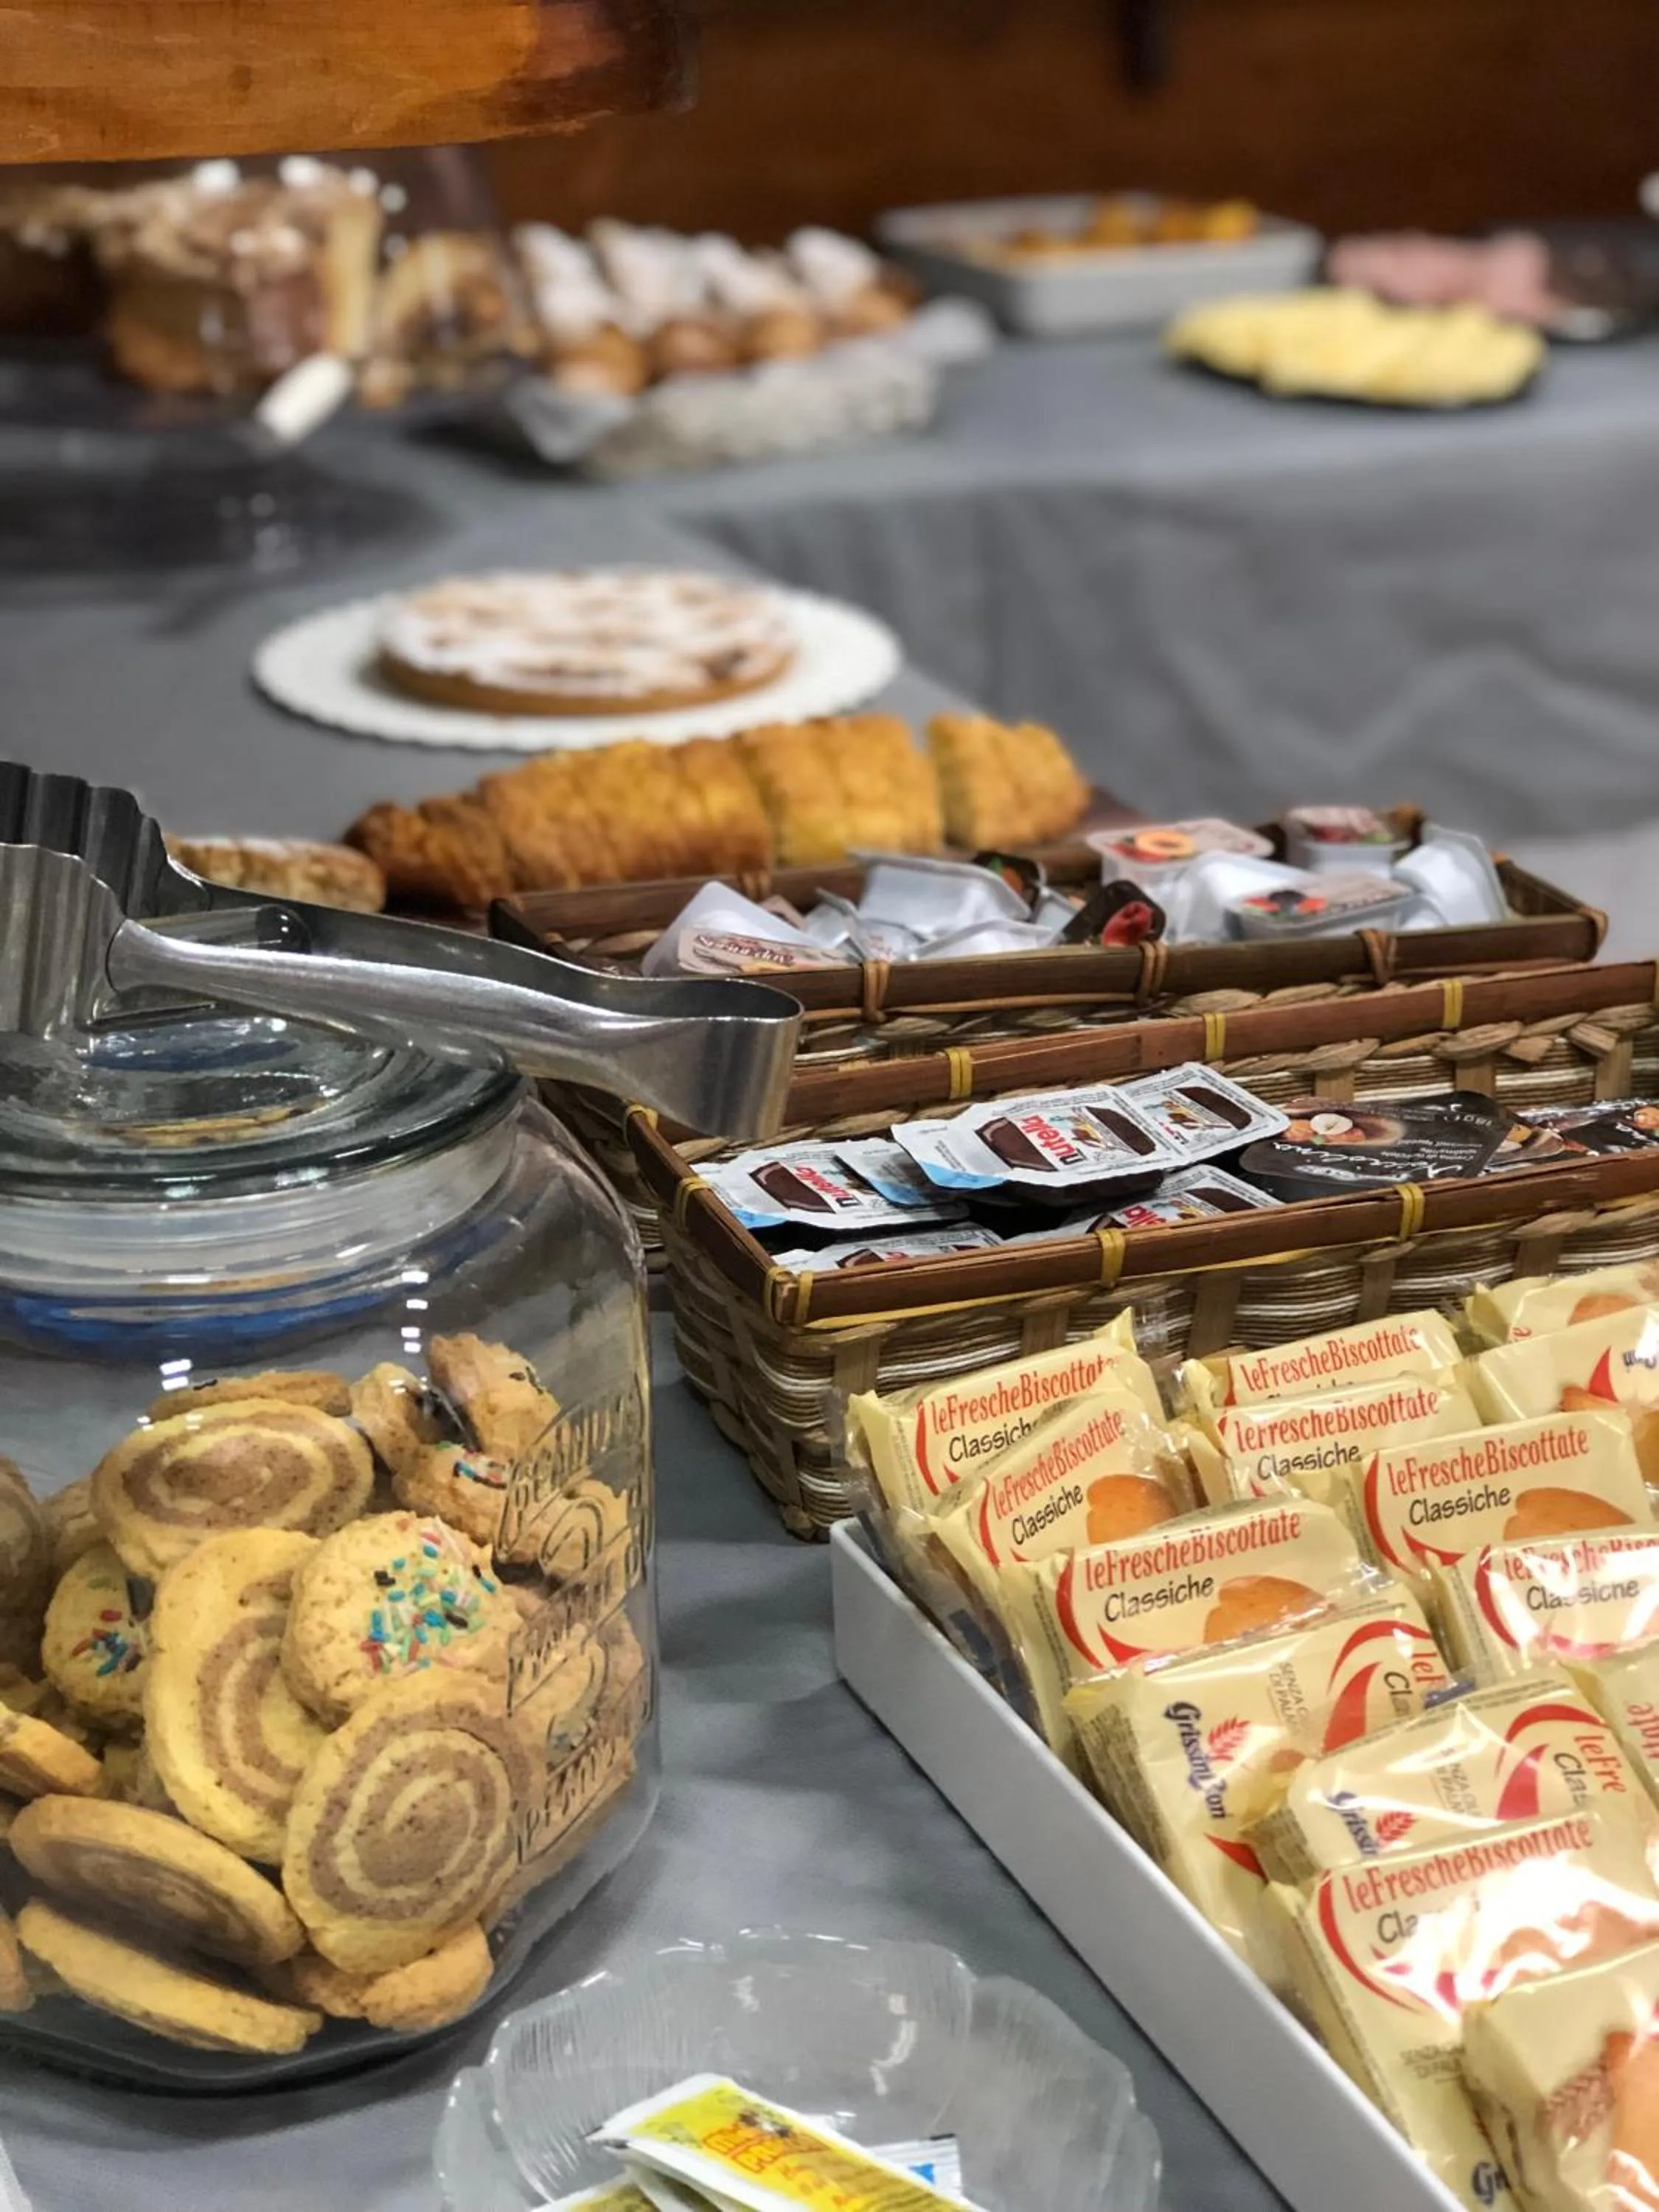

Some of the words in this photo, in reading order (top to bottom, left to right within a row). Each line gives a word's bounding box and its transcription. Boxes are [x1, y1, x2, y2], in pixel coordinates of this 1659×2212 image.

[949, 1417, 1037, 1462] Classich
[1235, 1388, 1439, 1453] leFrescheBiscottate
[992, 1408, 1124, 1520] leFrescheBiscottate
[1257, 1441, 1363, 1481] Classiche
[1387, 1426, 1590, 1496] leFrescheBiscottate
[1012, 1484, 1083, 1545] Classiche
[1409, 1484, 1511, 1526] Classiche
[1085, 1509, 1301, 1591] leFrescheBiscottate
[1105, 1574, 1214, 1622] Classiche
[1343, 1818, 1593, 1914] leFrescheBiscottate
